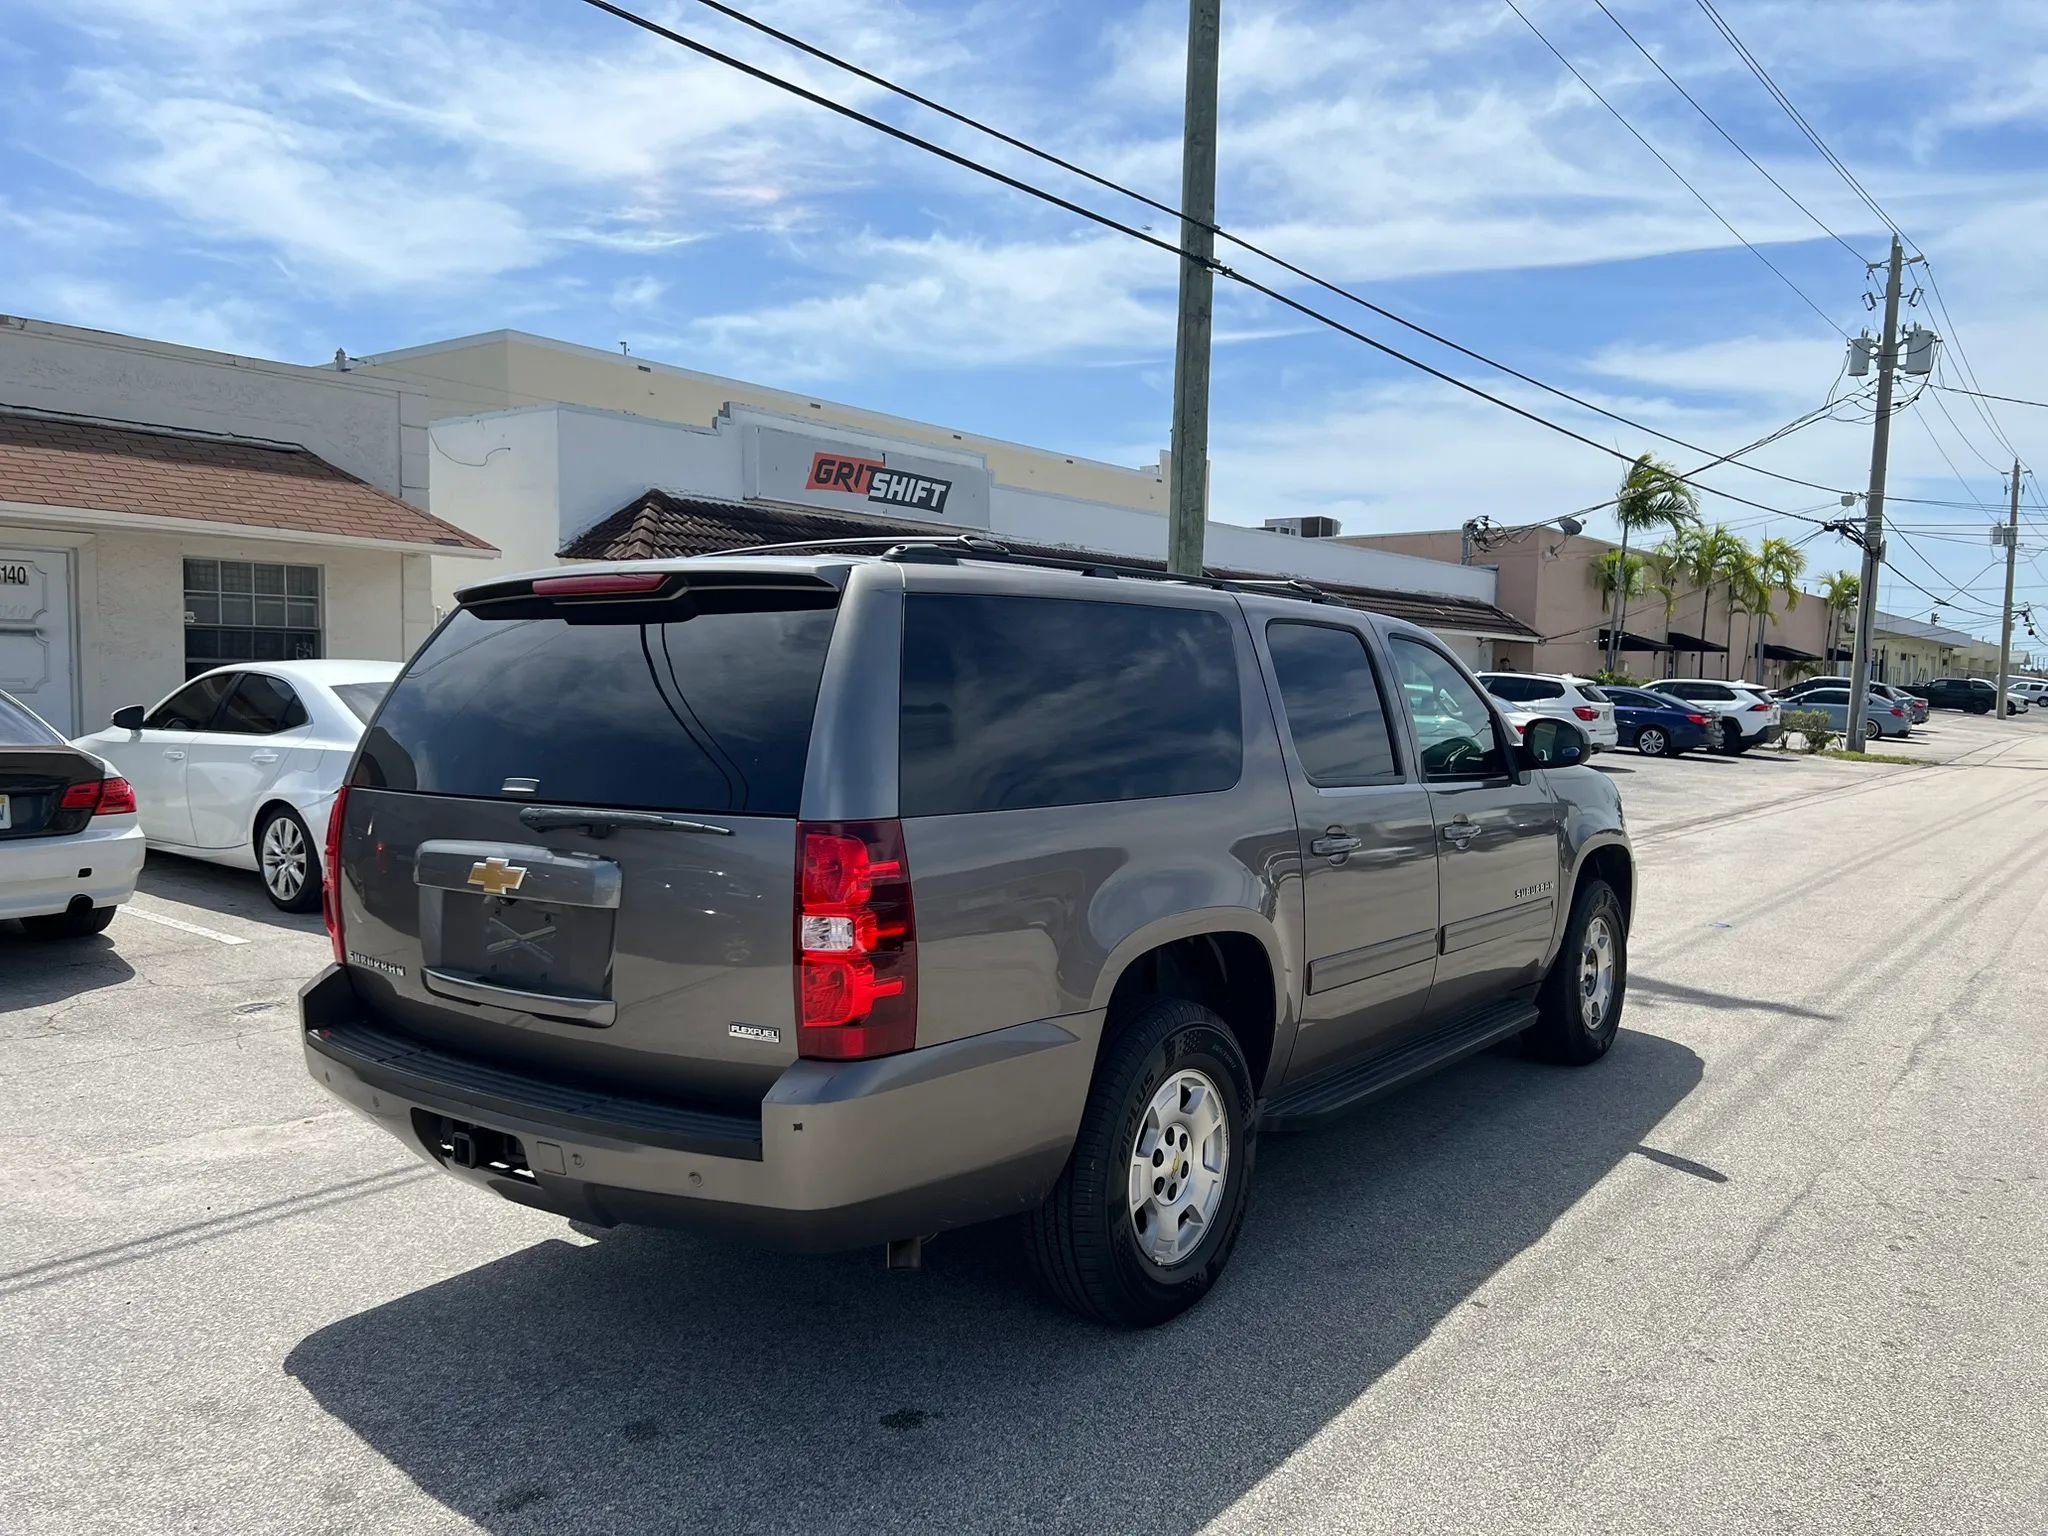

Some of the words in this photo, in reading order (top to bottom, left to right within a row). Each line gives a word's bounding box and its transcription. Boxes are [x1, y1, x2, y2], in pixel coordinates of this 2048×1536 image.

[870, 472, 947, 507] SHIFT
[0, 565, 26, 584] 140
[1514, 881, 1554, 899] SUBURBAN
[348, 950, 406, 977] SUBURBAN
[731, 1025, 777, 1038] FLEXFUEL
